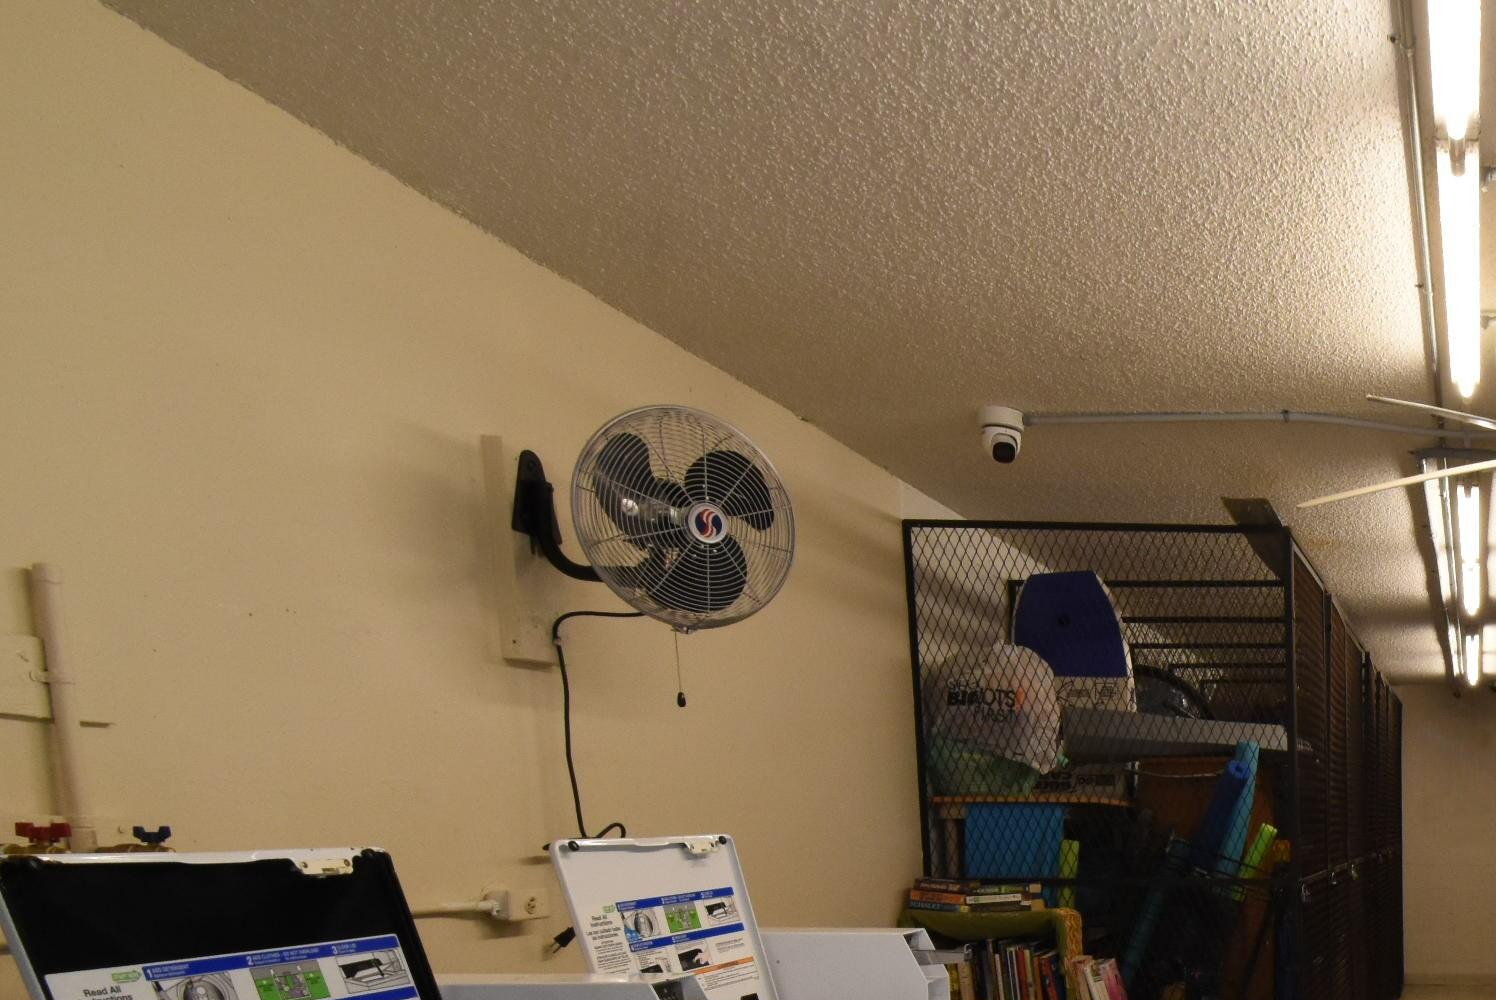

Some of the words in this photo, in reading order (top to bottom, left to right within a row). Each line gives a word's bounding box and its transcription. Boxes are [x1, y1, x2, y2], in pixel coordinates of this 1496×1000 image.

[332, 946, 337, 954] 3
[246, 956, 253, 965] 2
[83, 988, 107, 997] Read
[111, 985, 122, 993] All
